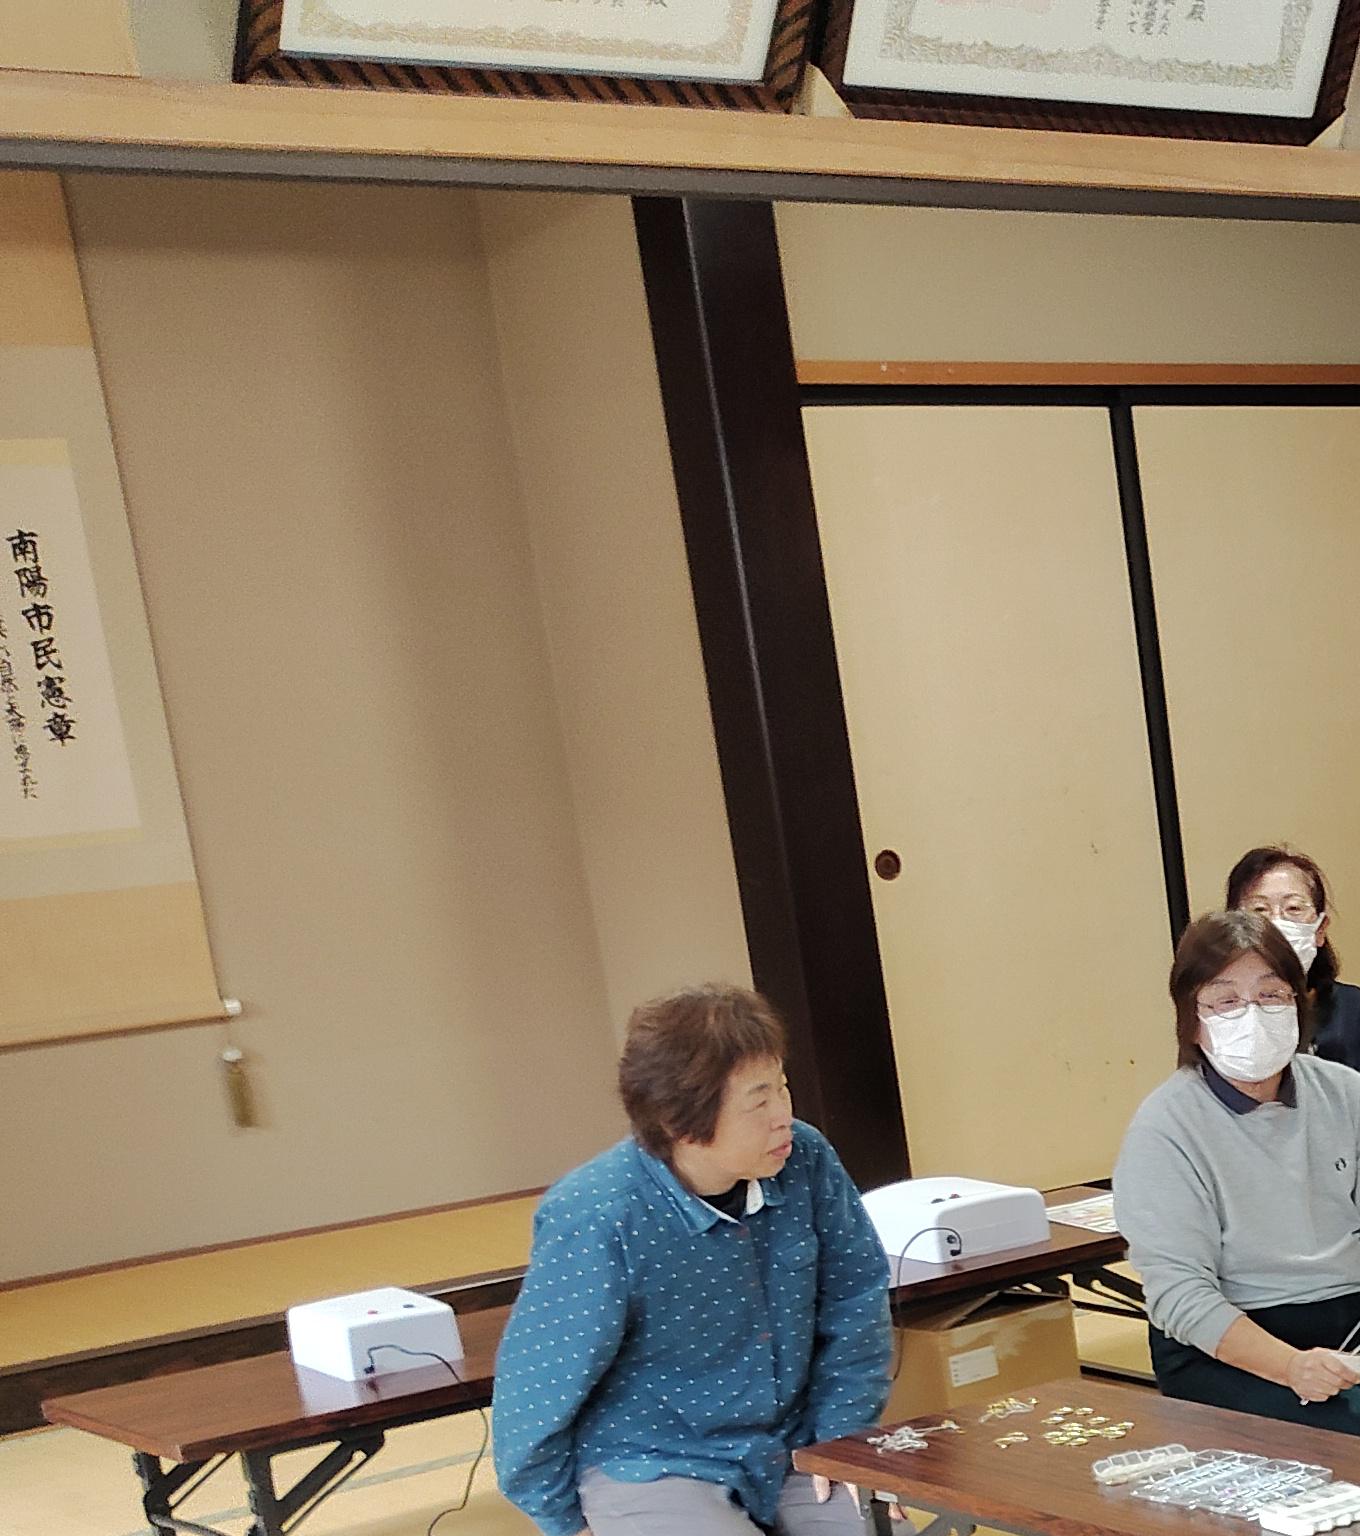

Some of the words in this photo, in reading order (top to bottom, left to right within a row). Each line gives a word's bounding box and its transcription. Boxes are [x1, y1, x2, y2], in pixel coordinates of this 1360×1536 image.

[6, 529, 76, 746] 南陽市民憲章
